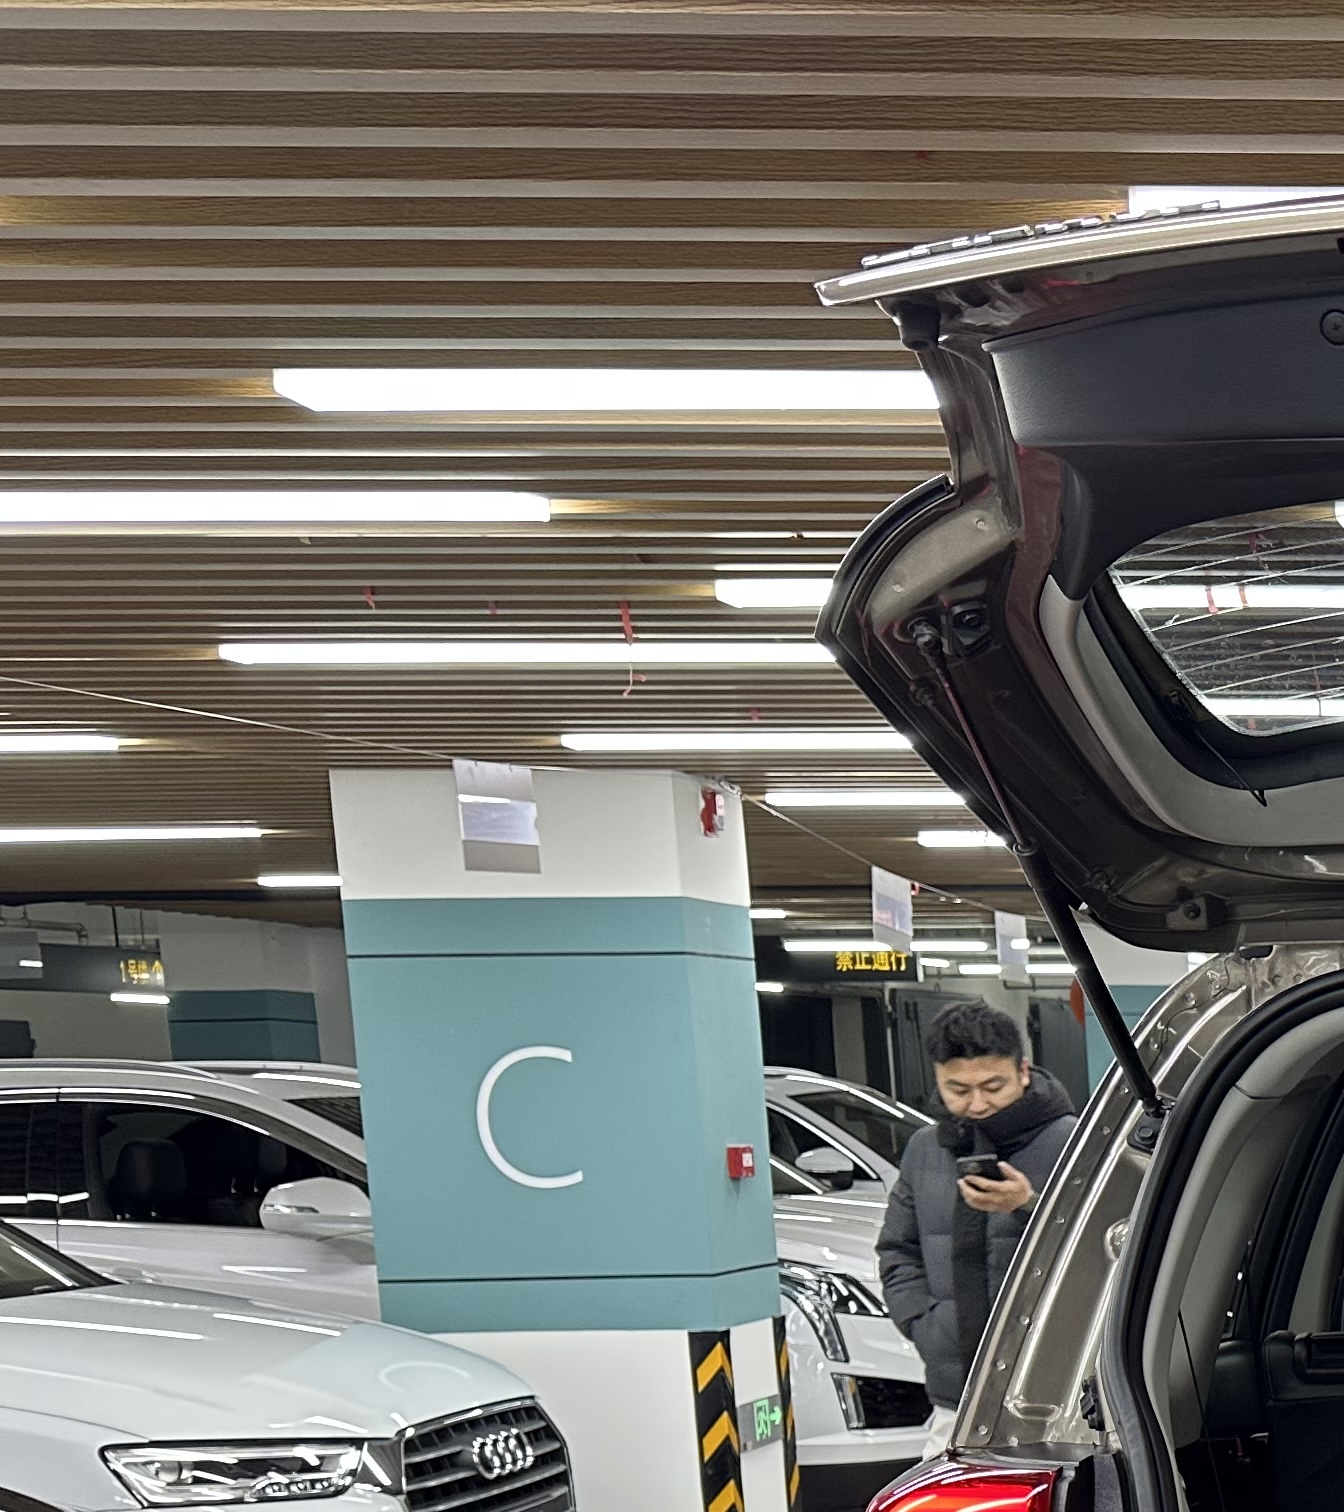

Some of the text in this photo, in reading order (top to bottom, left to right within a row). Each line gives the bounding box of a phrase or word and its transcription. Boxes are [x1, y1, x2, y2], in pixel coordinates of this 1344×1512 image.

[836, 952, 906, 971] 禁止通行
[476, 1046, 584, 1189] C
